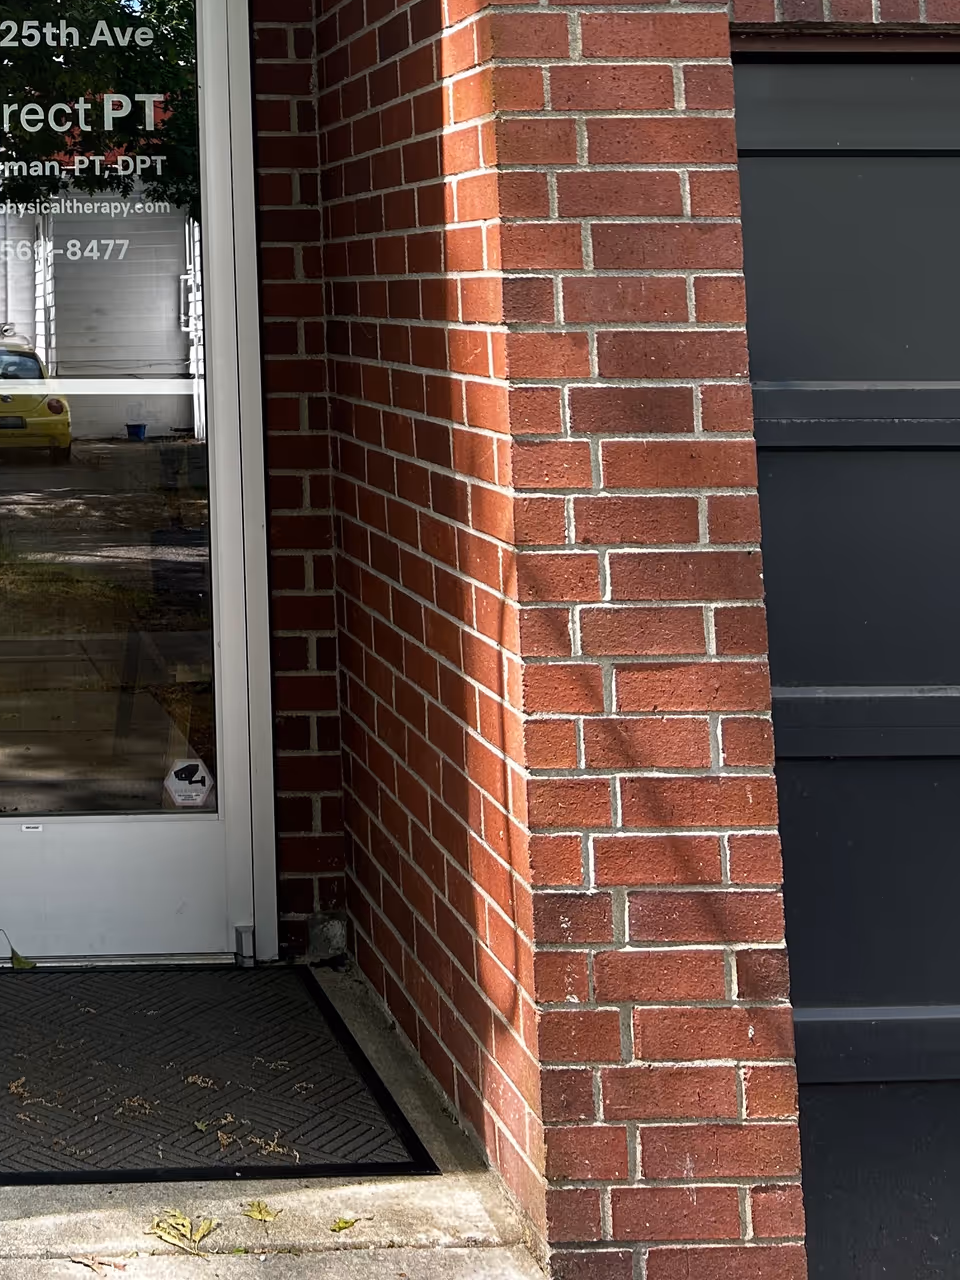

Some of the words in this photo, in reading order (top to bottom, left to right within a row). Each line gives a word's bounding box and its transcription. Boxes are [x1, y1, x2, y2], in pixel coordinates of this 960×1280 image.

[0, 20, 80, 47] 25th
[89, 19, 154, 47] Ave
[103, 93, 164, 131] PT
[74, 155, 111, 179] PT,
[117, 155, 167, 176] DPT
